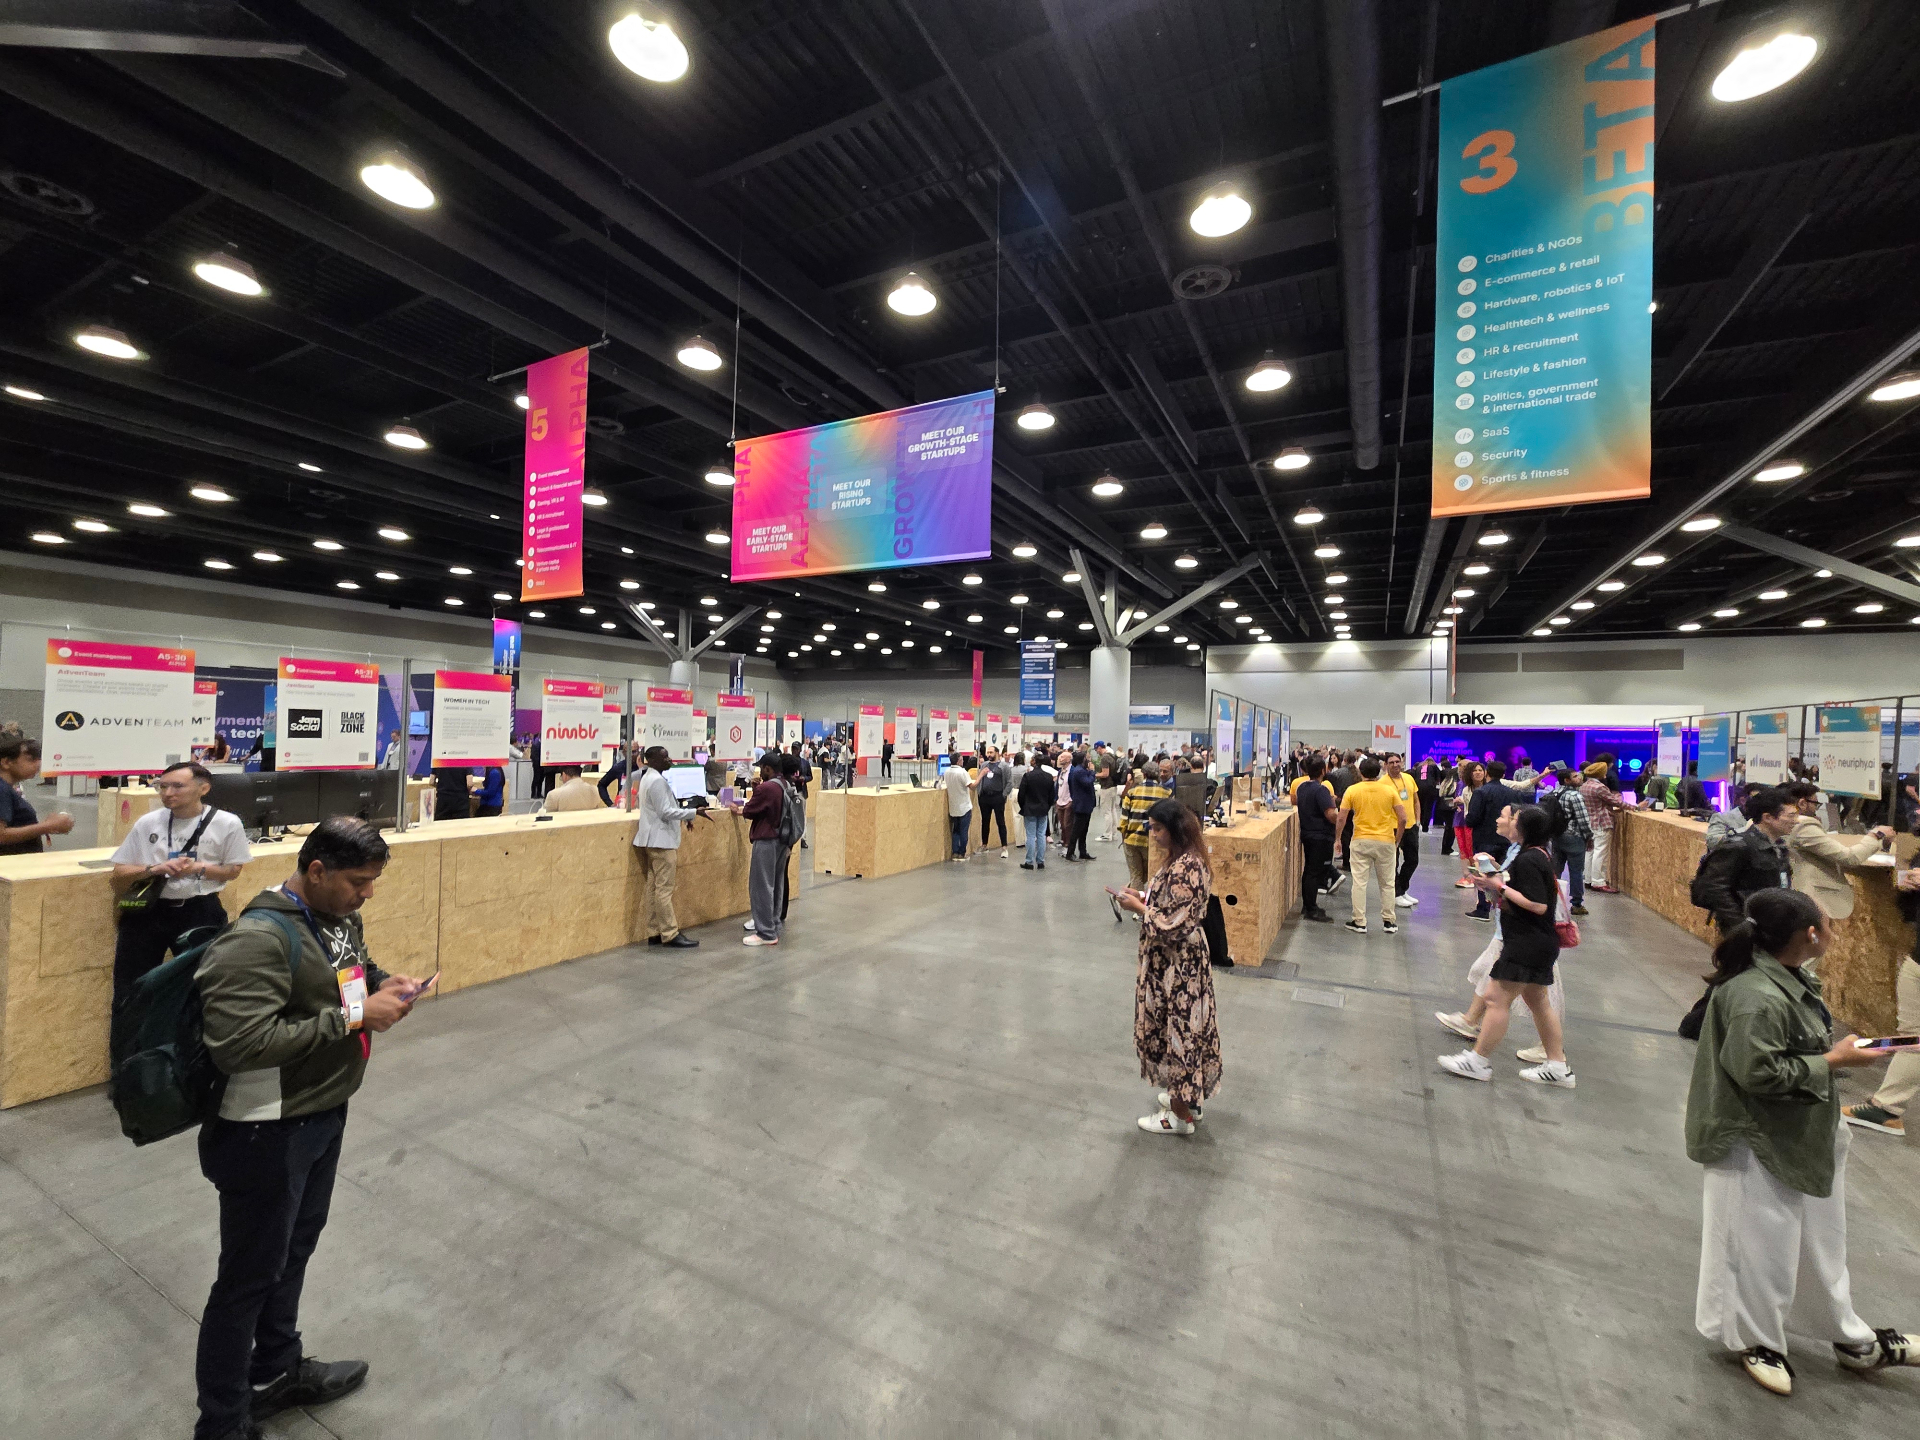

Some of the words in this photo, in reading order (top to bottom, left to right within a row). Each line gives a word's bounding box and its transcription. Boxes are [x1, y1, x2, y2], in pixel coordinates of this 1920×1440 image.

[1583, 26, 1655, 236] BETA
[1460, 129, 1518, 194] 3
[1485, 248, 1534, 264] Charities
[1536, 243, 1545, 253] &
[1547, 236, 1583, 251] NGOs
[1485, 266, 1556, 287] E-commerce
[1558, 262, 1567, 272] &
[1569, 255, 1600, 270] retail
[1484, 293, 1541, 310] Hardware,
[1543, 281, 1592, 299] robotics
[1594, 278, 1603, 288] &
[1606, 273, 1625, 286] IoT
[1484, 315, 1544, 333] Healthtech
[1546, 312, 1555, 322] &
[1558, 302, 1611, 320] wellness
[1483, 346, 1500, 357] HR
[1502, 344, 1510, 353] &
[1512, 332, 1580, 352] recruitment
[1483, 365, 1530, 380] Lifestyle
[1532, 363, 1541, 373] &
[1543, 356, 1587, 371] fashion
[1482, 391, 1525, 403] Politics,
[1528, 378, 1599, 398] government
[1482, 405, 1491, 415] &
[1492, 394, 1563, 413] international
[1565, 390, 1597, 403] trade
[531, 407, 549, 442] 5
[1482, 426, 1511, 438] SaaS
[921, 429, 946, 442] MEET
[945, 425, 965, 437] OUR
[907, 433, 980, 453] GROWTH-STAGE
[920, 445, 967, 461] STARTUPS
[1482, 448, 1528, 461] Security
[1481, 473, 1518, 486] Sports
[1520, 471, 1528, 481] &
[1530, 468, 1570, 479] fitness
[832, 481, 853, 493] MEET
[854, 478, 872, 489] OUR
[838, 488, 864, 500] RISING
[831, 496, 872, 511] STARTUPS
[752, 526, 772, 537] MEET
[771, 524, 787, 534] OUR
[746, 532, 794, 546] EARLY-STAGE
[751, 542, 788, 554] STARTUPS
[157, 653, 187, 662] A5-30
[604, 684, 619, 695] EXIT
[89, 717, 184, 728] ADVENTEAM
[298, 715, 321, 724] Jam
[340, 711, 366, 720] BLACK
[1439, 710, 1496, 725] make
[290, 722, 320, 732] Social
[340, 723, 365, 734] ZONE
[1375, 724, 1401, 739] NL
[1759, 757, 1782, 768] Measure
[1837, 757, 1876, 771] neuriphy.ai
